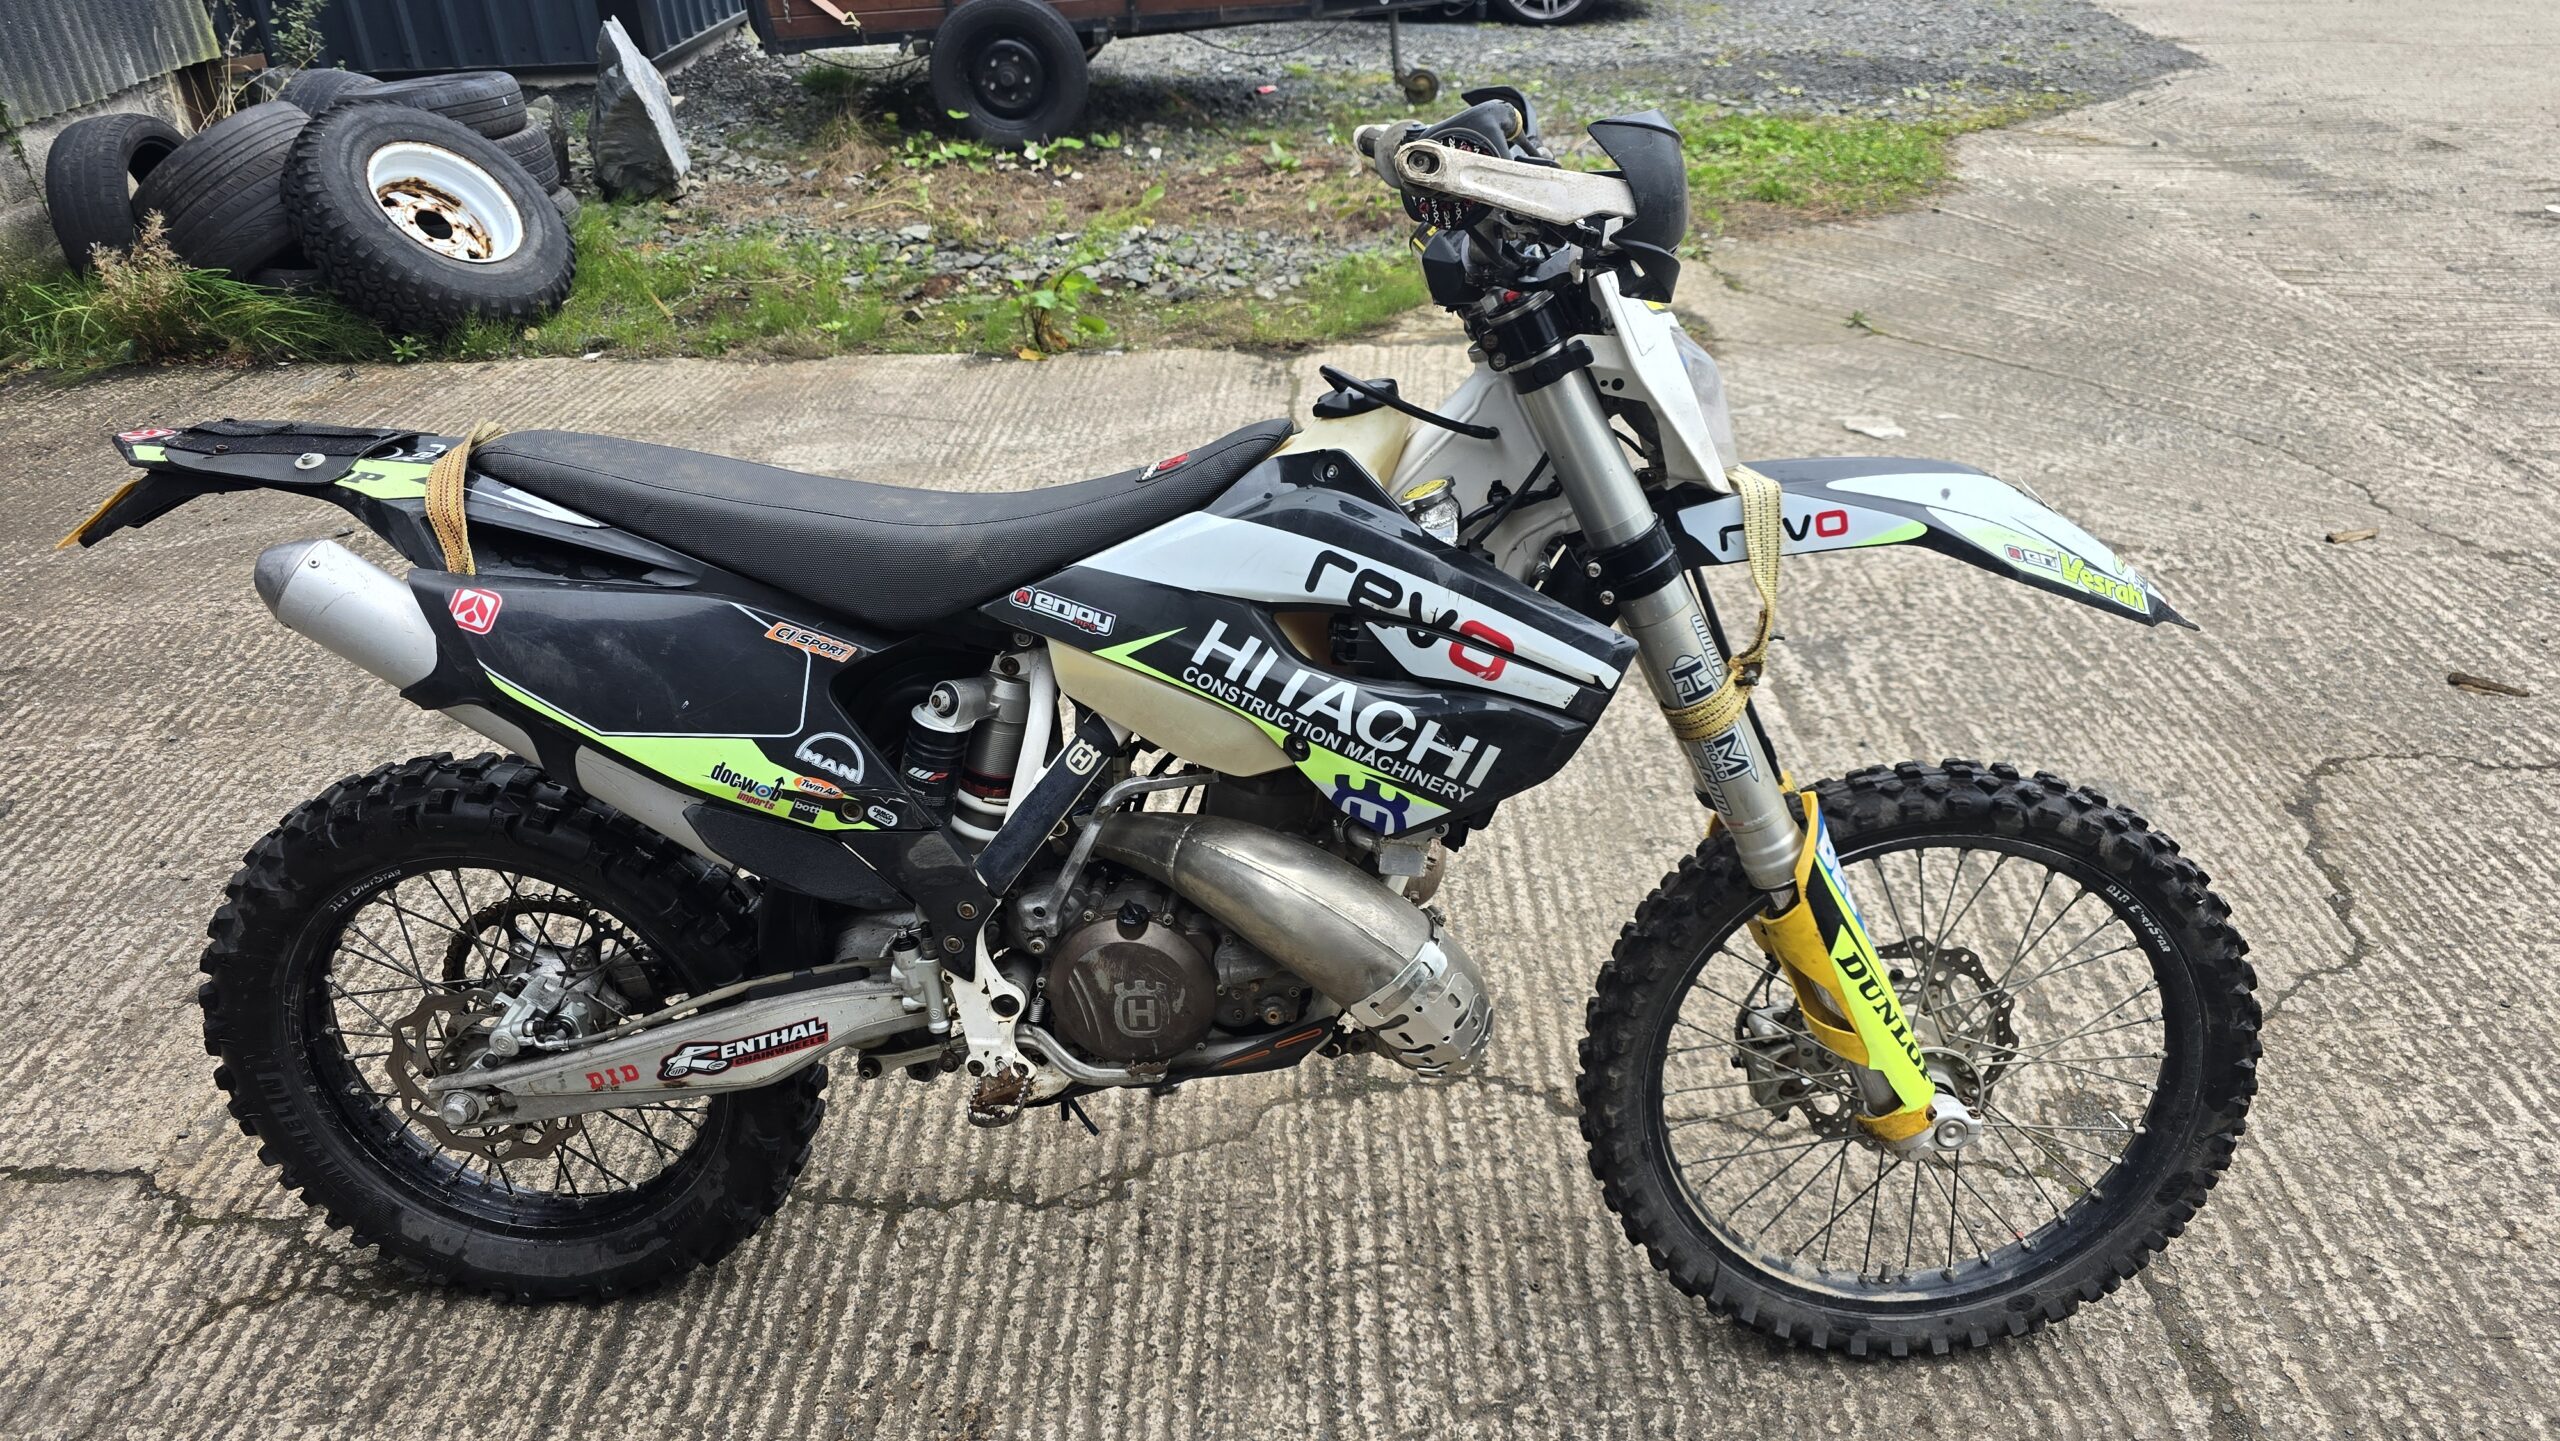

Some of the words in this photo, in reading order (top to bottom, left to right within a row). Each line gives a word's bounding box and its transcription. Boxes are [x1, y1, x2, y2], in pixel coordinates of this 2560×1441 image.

[1719, 509, 1849, 551] rvo
[2058, 551, 2146, 612] Vesrah
[1033, 592, 1113, 633] enjoy
[1304, 549, 1515, 682] revo
[775, 628, 796, 640] CI
[1190, 619, 1502, 788] HITACHI
[1182, 666, 1341, 751] CONSTRUCTION
[1344, 741, 1476, 803] MACHINERY
[801, 749, 859, 784] MAN
[907, 767, 949, 781] WP
[736, 791, 776, 811] imports
[800, 779, 824, 792] Twin
[823, 786, 839, 796] Air
[794, 801, 820, 814] bott
[665, 1020, 826, 1078] RENTHAL
[734, 1035, 827, 1066] CHAINWHEELS
